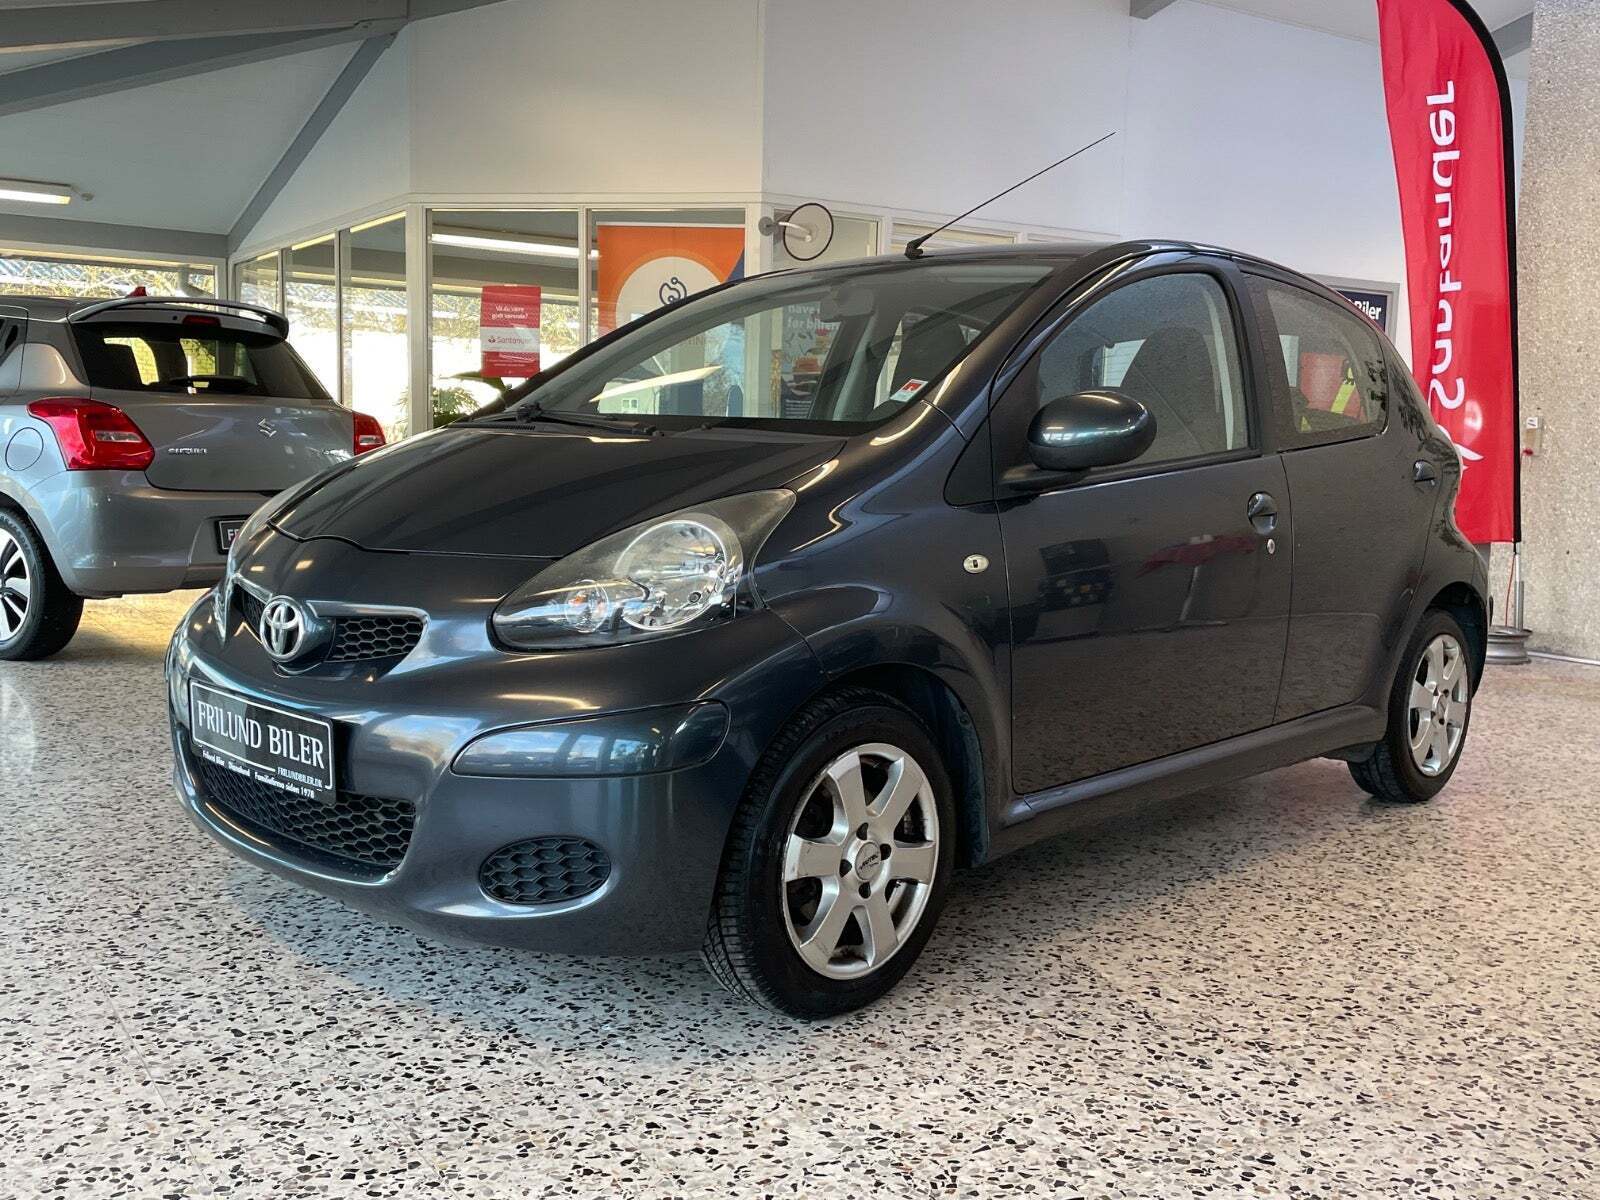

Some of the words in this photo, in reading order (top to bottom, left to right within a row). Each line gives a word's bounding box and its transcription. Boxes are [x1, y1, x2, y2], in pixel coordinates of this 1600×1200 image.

[197, 700, 262, 749] FRILUND
[267, 724, 325, 769] BILER
[300, 786, 315, 799] 1978
